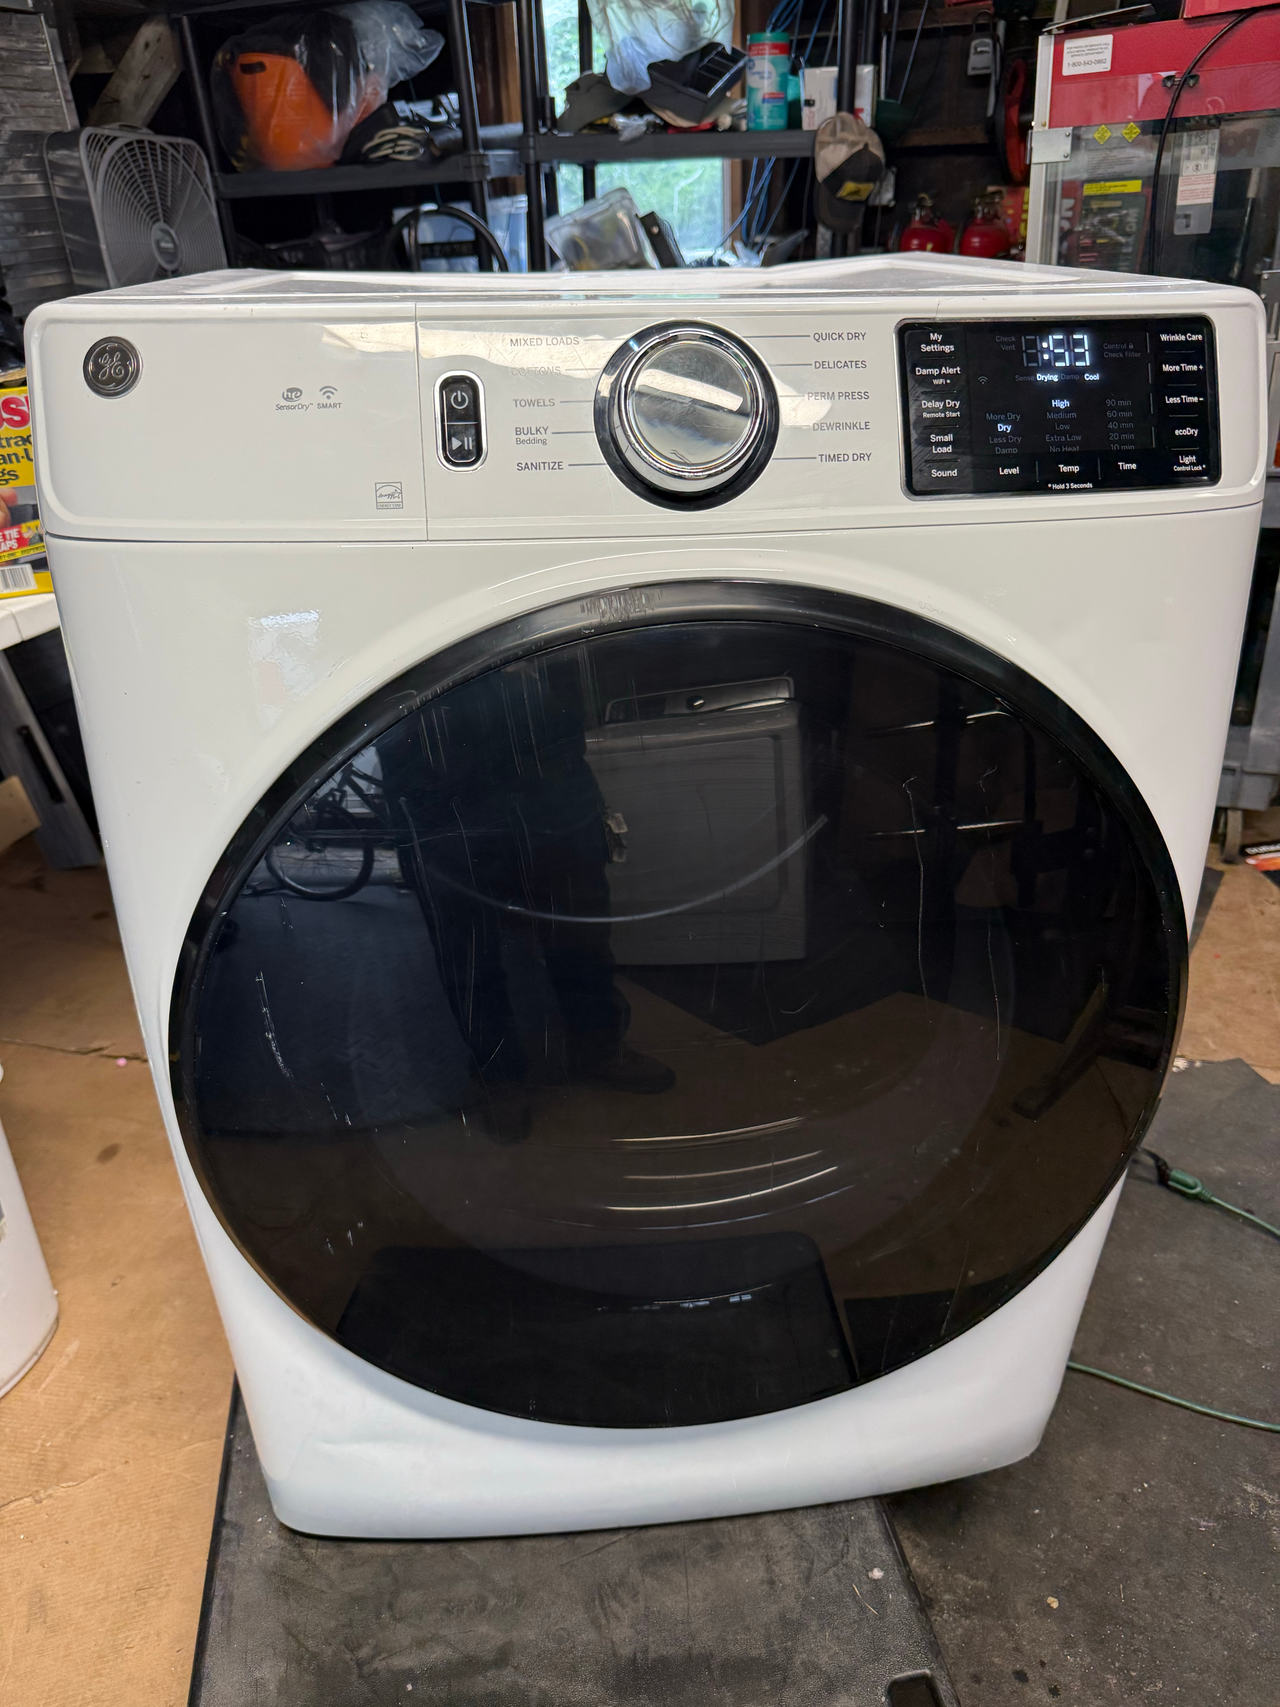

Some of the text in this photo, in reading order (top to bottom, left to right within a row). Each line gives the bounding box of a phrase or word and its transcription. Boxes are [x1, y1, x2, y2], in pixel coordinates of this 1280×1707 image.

[813, 332, 867, 342] QUICK DRY
[929, 333, 942, 342] My
[1186, 333, 1203, 341] Care
[510, 337, 580, 347] MIXED LOADS
[920, 344, 955, 353] Settings
[814, 360, 867, 370] DELICATES
[1162, 364, 1180, 372] More
[1180, 363, 1198, 371] Time
[915, 366, 961, 376] Damp Alert
[1036, 373, 1059, 382] Drying
[1084, 373, 1100, 381] Cool
[807, 391, 870, 401] PERM PRESS
[1165, 396, 1181, 404] Less
[1181, 395, 1198, 403] Time
[317, 402, 343, 410] SMART
[512, 398, 556, 408] TOWELS
[921, 399, 960, 409] Delay Dry
[1051, 399, 1070, 409] High
[1105, 399, 1116, 407] 90
[986, 412, 1021, 422] More Dry
[1046, 411, 1077, 419] Medium
[812, 421, 871, 431] DEWRINKLE
[997, 424, 1012, 433] Dry
[1055, 423, 1070, 431] Low
[514, 426, 549, 436] BULKY
[1174, 428, 1199, 437] ecoDry
[515, 437, 547, 446] Bedding
[930, 434, 953, 442] Small
[989, 435, 1022, 445] Less Dry
[1046, 434, 1065, 442] Extra
[932, 445, 952, 453] Load
[818, 452, 872, 463] TIMED DRY
[1179, 455, 1196, 465] Light
[516, 461, 564, 472] SANITIZE
[999, 466, 1020, 475] Level
[1058, 464, 1080, 474] Temp
[1118, 462, 1137, 470] Time
[931, 469, 958, 477] Sound
